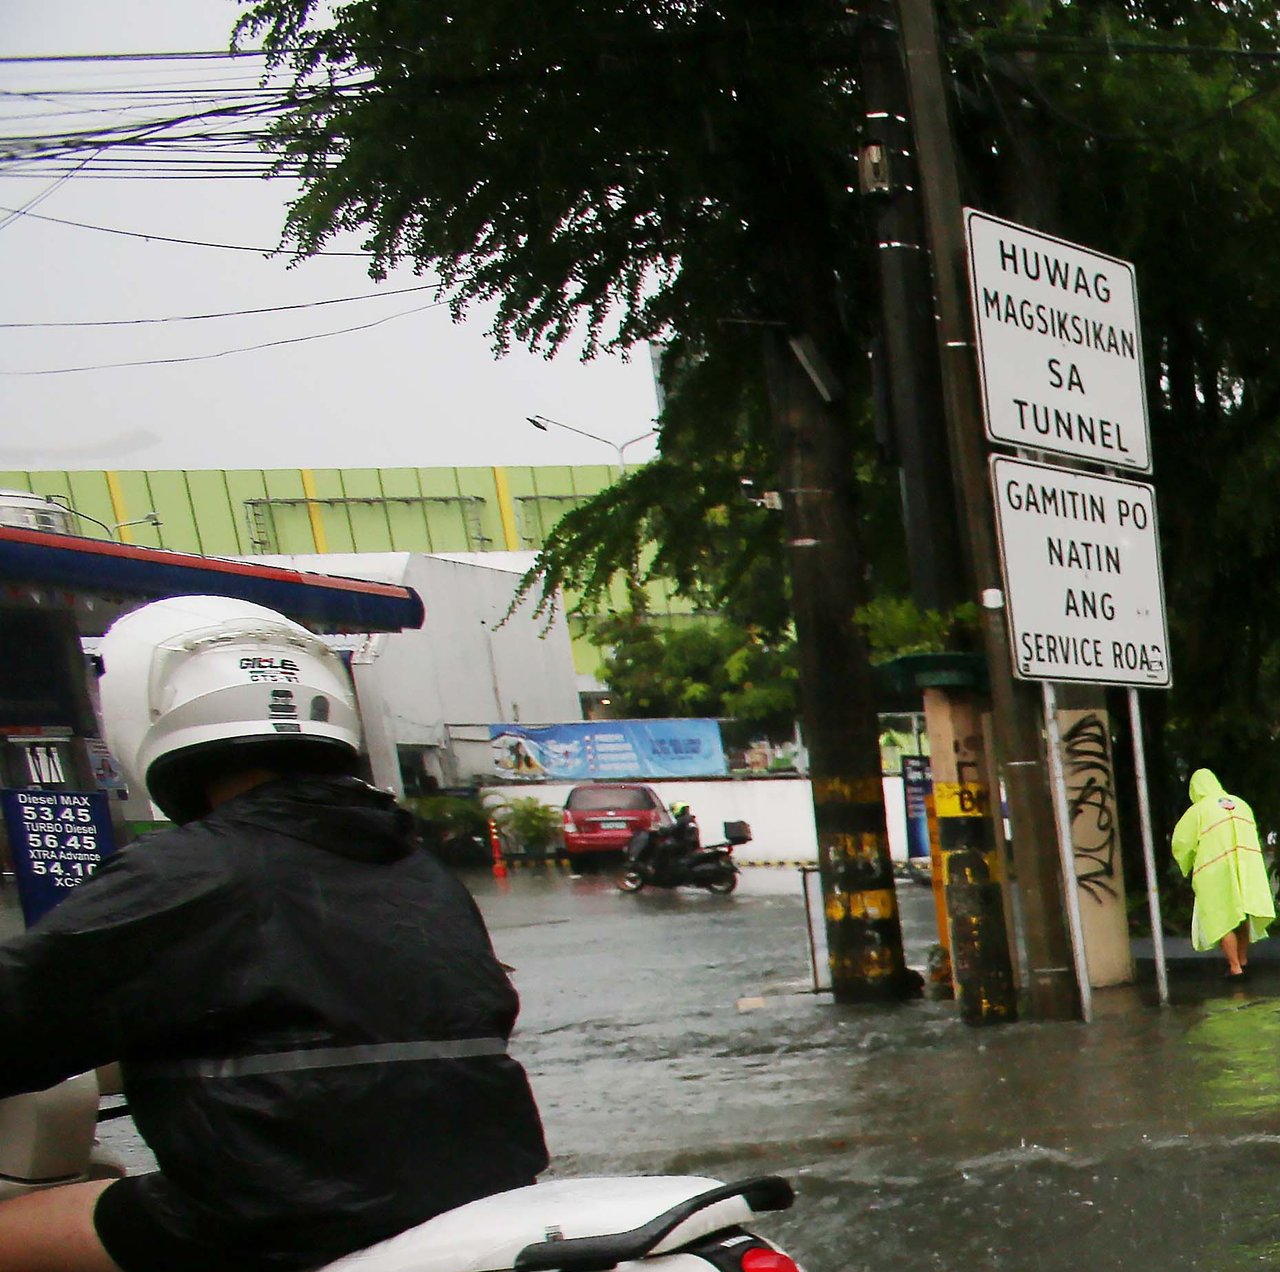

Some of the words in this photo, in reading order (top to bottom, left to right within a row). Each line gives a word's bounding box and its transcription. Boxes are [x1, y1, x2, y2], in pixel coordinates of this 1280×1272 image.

[999, 239, 1111, 303] HUWAG
[983, 287, 1136, 360] MAGSIKSIKAN
[1048, 358, 1086, 395] SA
[1013, 399, 1129, 453] TUNNEL
[1006, 480, 1107, 525] GAMITIN
[1118, 499, 1148, 530] PO
[1046, 536, 1122, 575] NATIN
[1065, 588, 1116, 621] ANG
[1021, 632, 1104, 668] SERVICE
[18, 793, 58, 805] Diesel
[60, 795, 91, 807] MAX
[23, 806, 92, 822] 53.45
[23, 821, 63, 833] TURBO
[65, 824, 97, 834] Diesel
[28, 833, 97, 850] 56.45
[29, 849, 57, 860] XTRA
[59, 851, 101, 861] Advance
